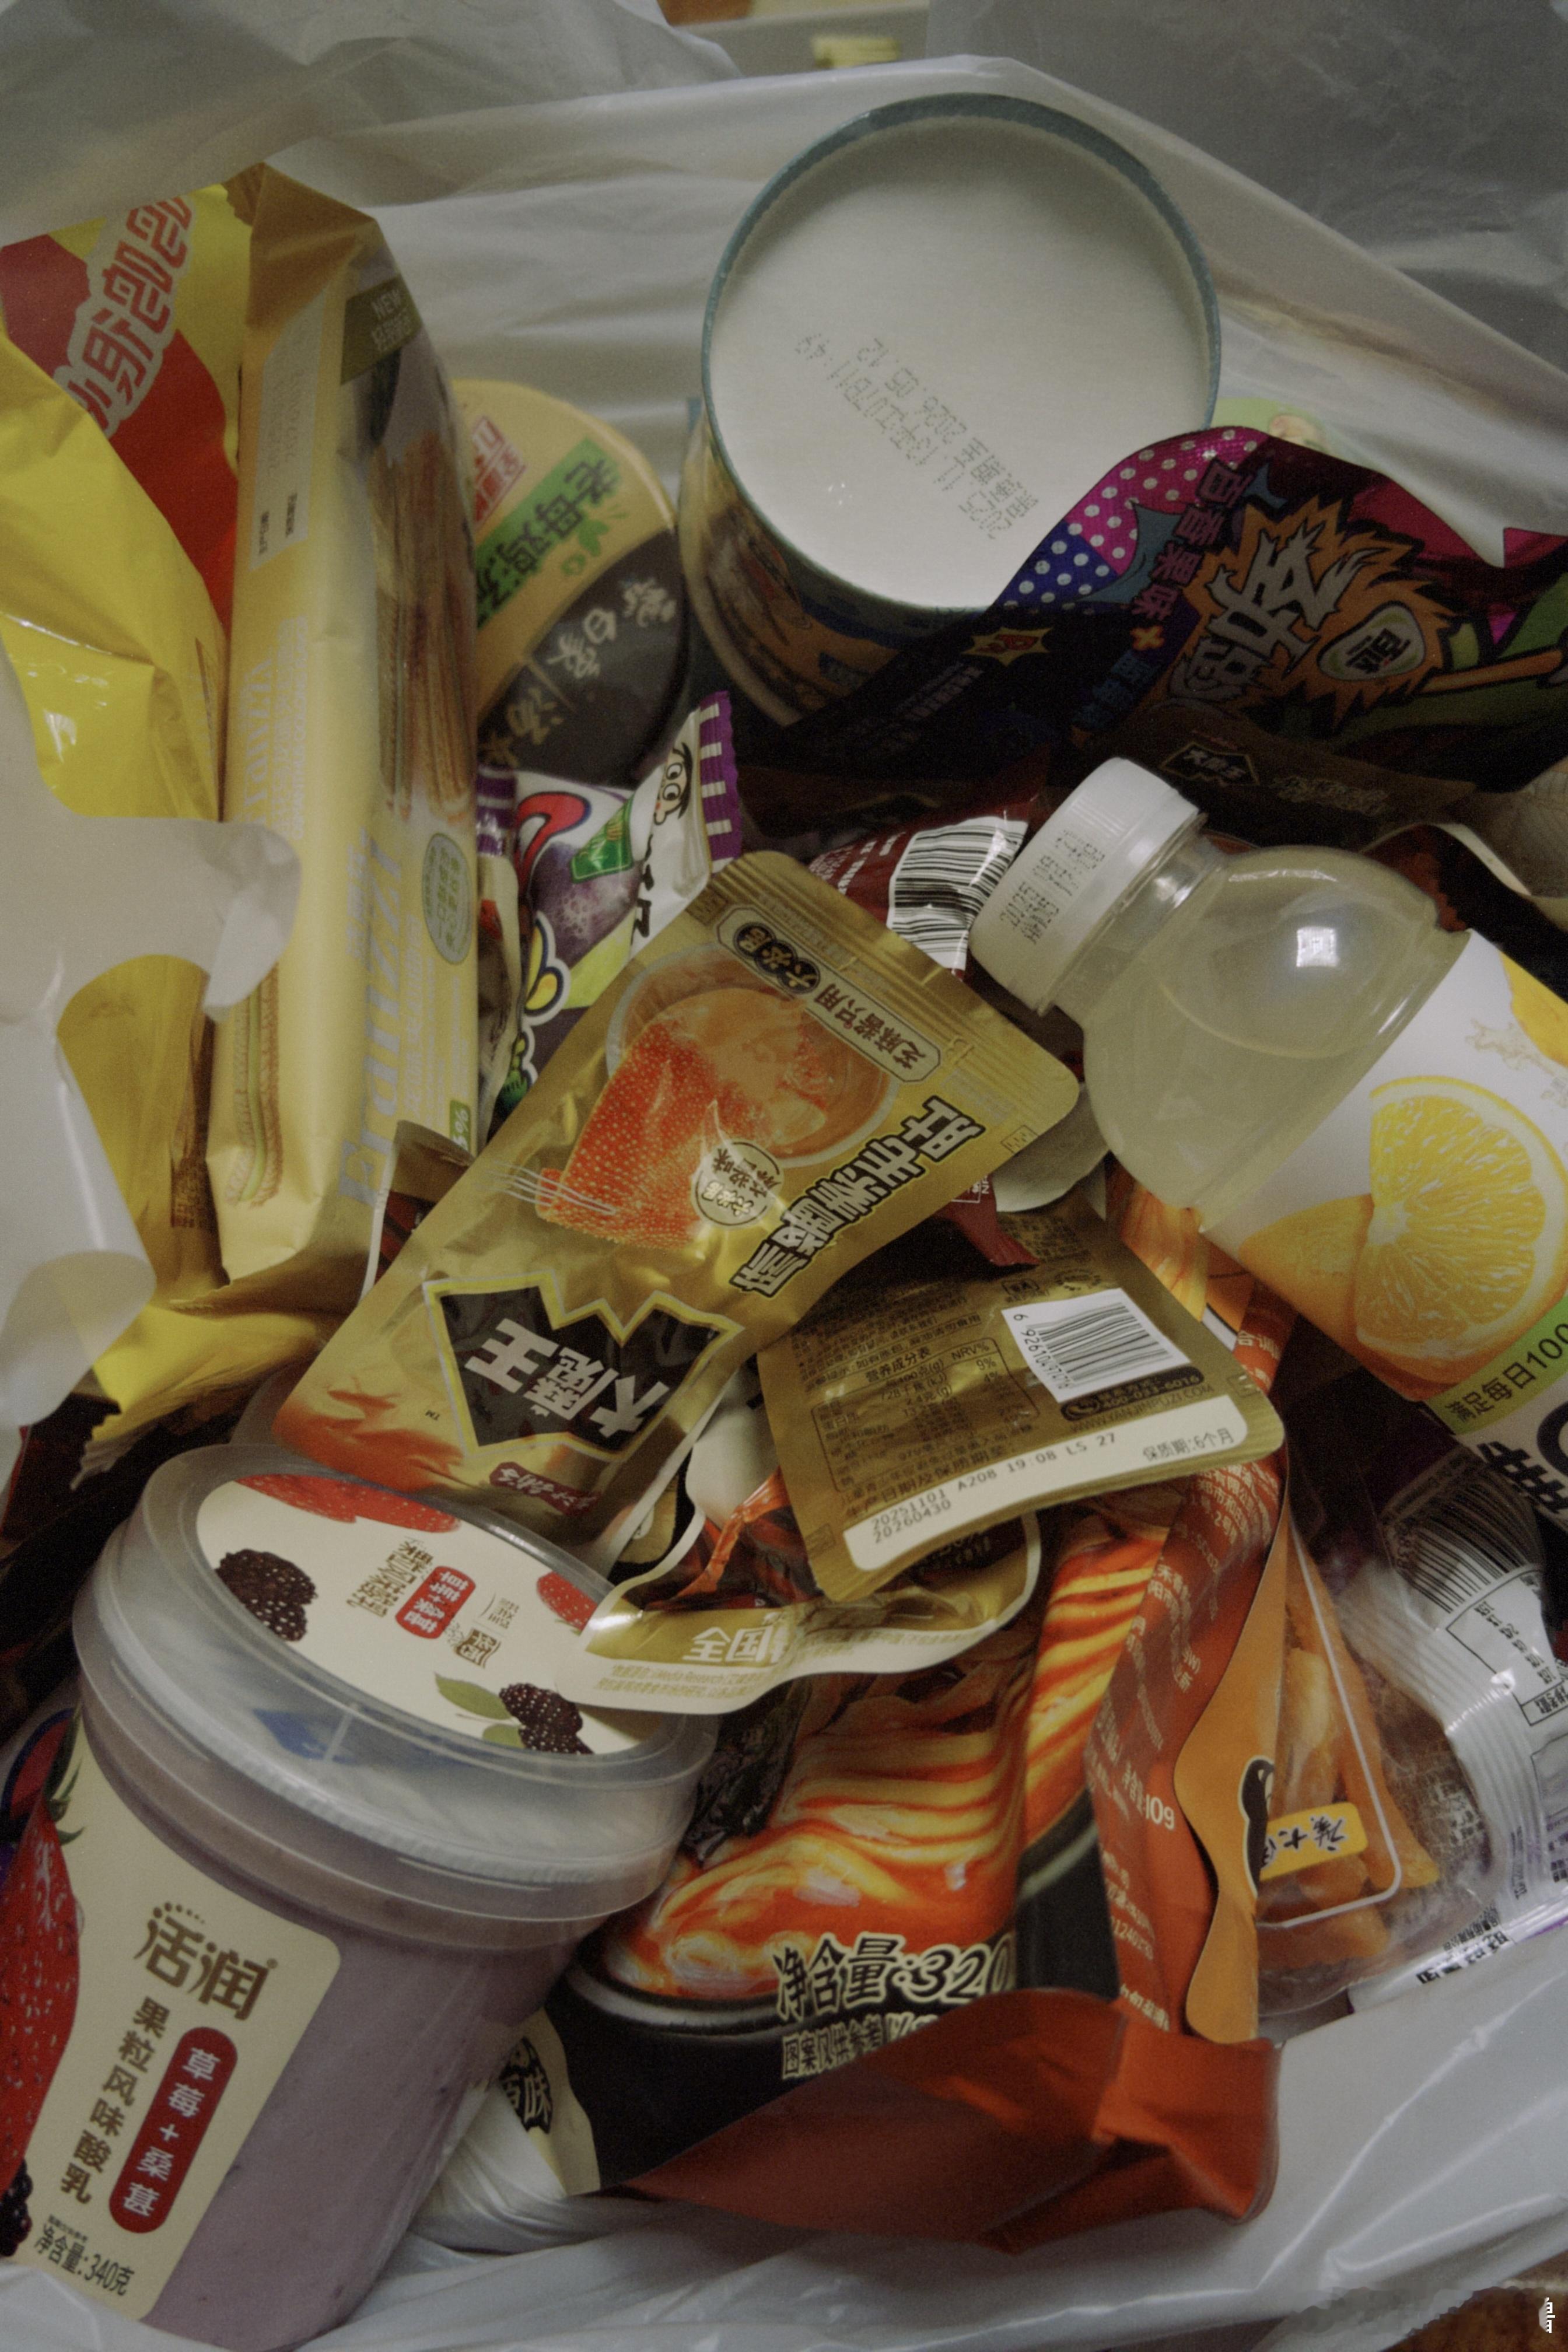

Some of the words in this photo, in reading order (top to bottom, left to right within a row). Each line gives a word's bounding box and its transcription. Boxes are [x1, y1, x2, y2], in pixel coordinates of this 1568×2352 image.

[337, 835, 402, 1206] Franzzi
[814, 982, 928, 1070] 芝麻酱只用
[464, 1317, 668, 1437] 大魔王
[866, 1346, 930, 1382] 营养成分表
[956, 1468, 999, 1493] A208
[1005, 1450, 1057, 1476] 19:08
[1095, 1432, 1118, 1450] 27
[1143, 1427, 1236, 1464] 保质期:6个月
[134, 1902, 270, 2021] 活润
[60, 1996, 172, 2205] 果粒风味酸乳
[121, 2046, 222, 2218] 草莓+桑葚
[33, 2224, 136, 2298] 净含量:340克
